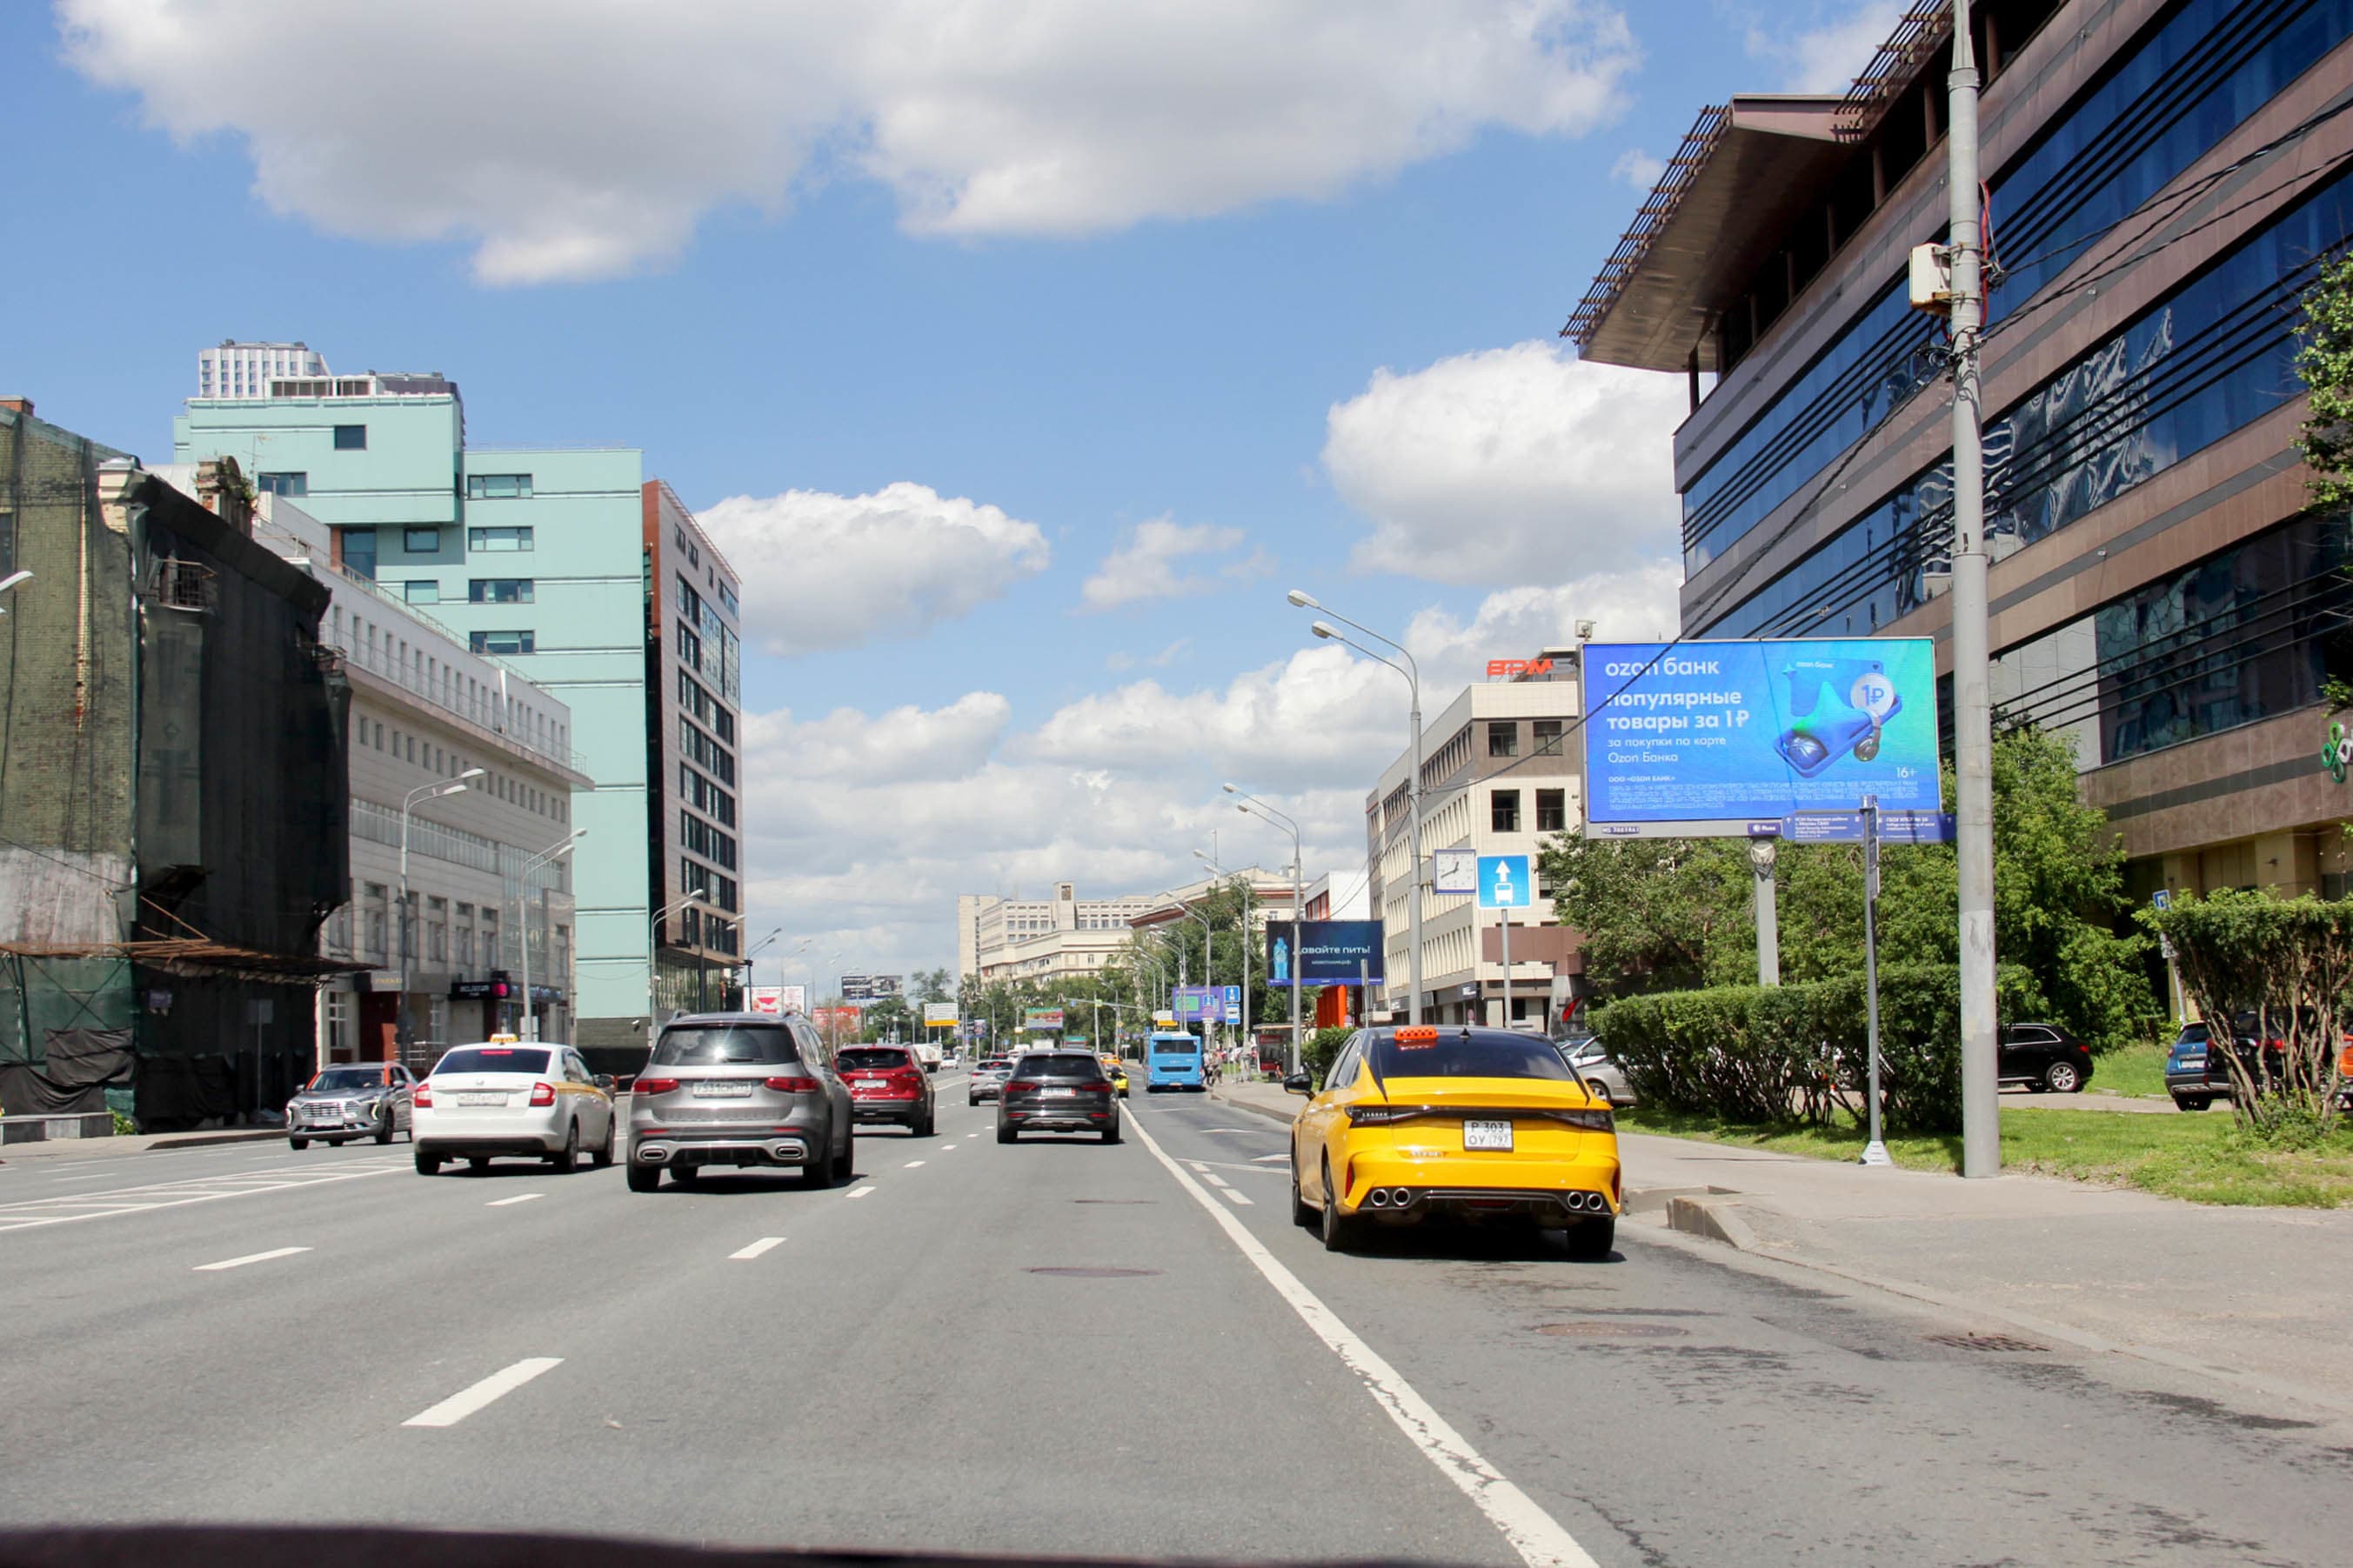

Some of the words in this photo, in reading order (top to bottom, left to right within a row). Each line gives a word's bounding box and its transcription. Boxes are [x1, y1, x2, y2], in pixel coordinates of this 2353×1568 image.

[1605, 662, 1659, 677] ozon
[1664, 657, 1720, 675] банк
[1607, 691, 1742, 710] популярные
[1607, 716, 1688, 734] товары
[1695, 715, 1719, 728] за
[1607, 738, 1621, 748] за
[1625, 737, 1672, 750] покупки
[1675, 737, 1690, 746] по
[1694, 737, 1727, 749] карте
[1608, 752, 1639, 764] Ozon
[1642, 751, 1679, 763] Банка
[1896, 767, 1918, 779] 16+
[1293, 945, 1340, 955] авайте
[1342, 945, 1371, 955] пить!
[1483, 1122, 1504, 1132] 303
